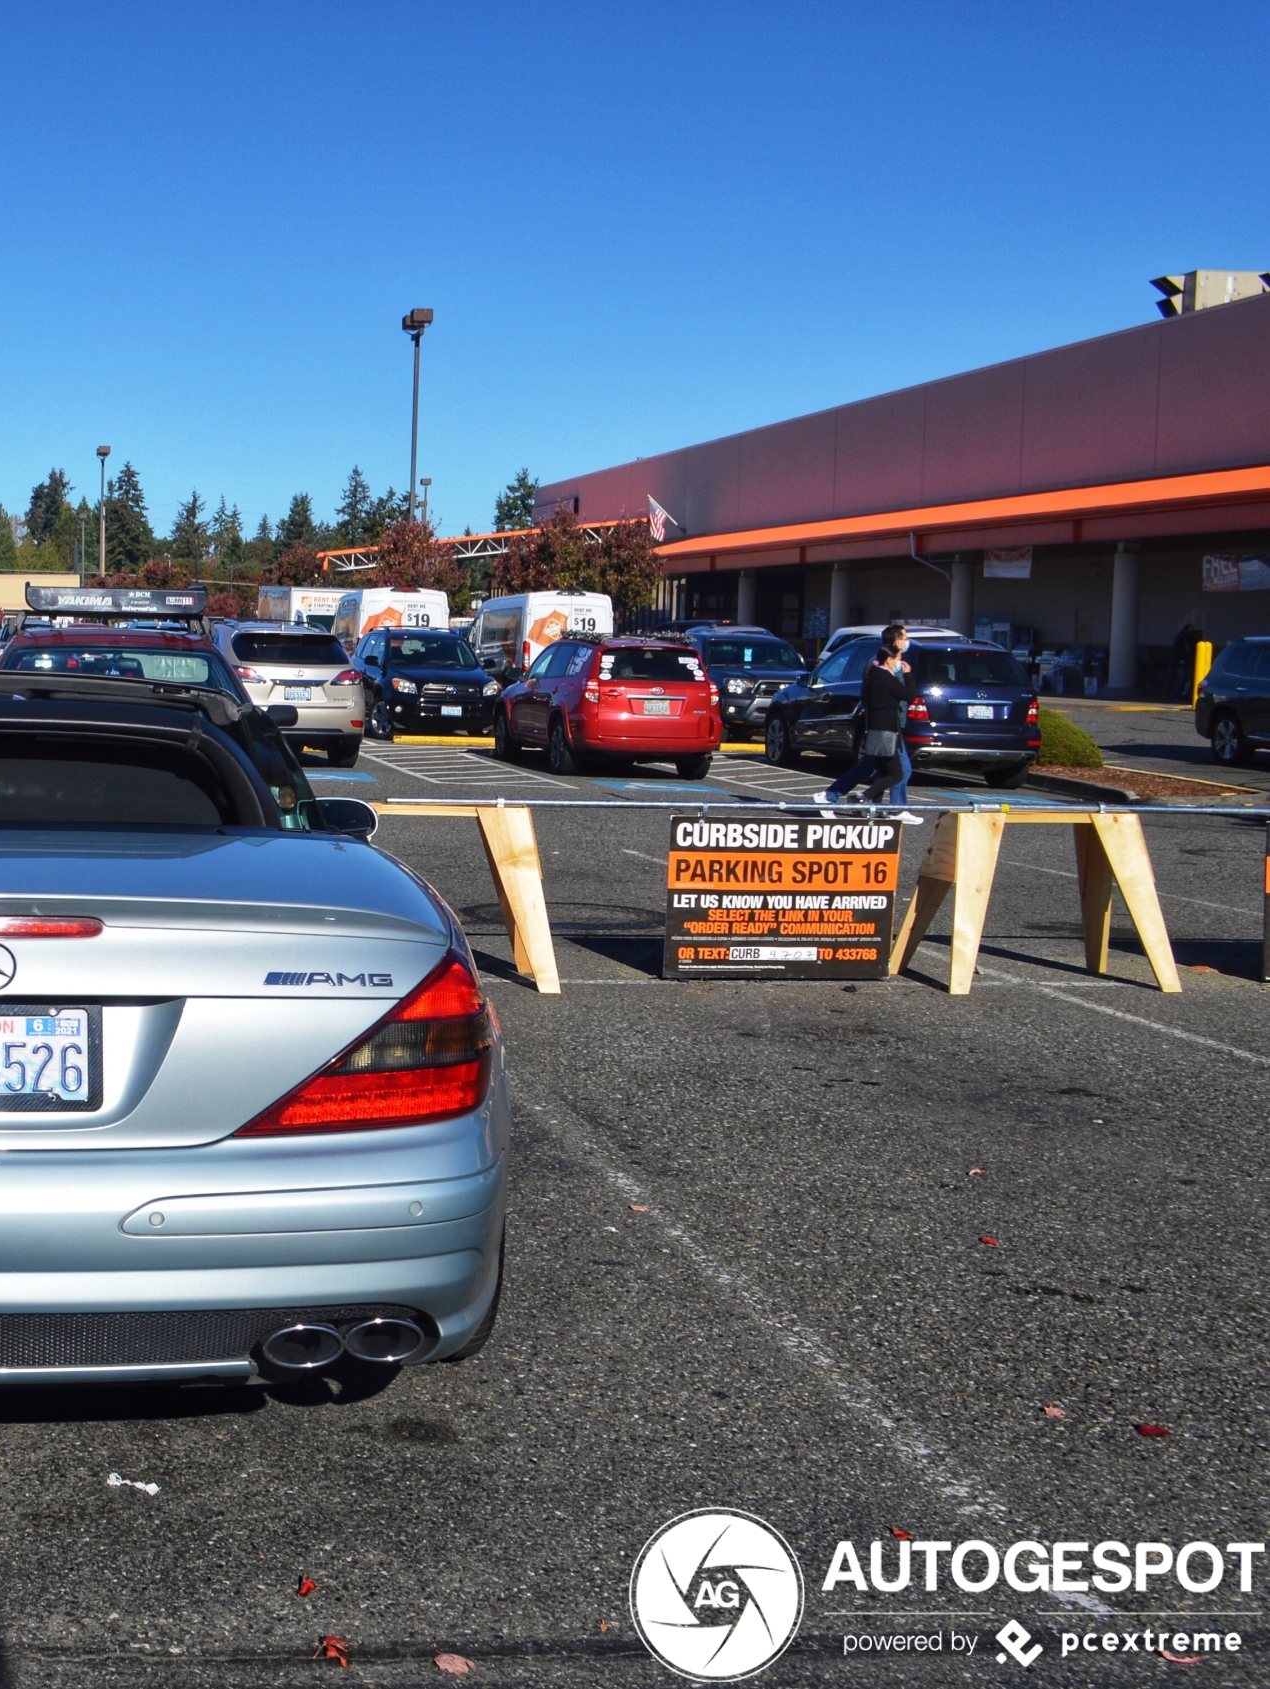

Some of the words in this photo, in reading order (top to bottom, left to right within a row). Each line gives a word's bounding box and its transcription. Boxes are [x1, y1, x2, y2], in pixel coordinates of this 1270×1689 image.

[1203, 555, 1238, 578] FREE
[57, 596, 112, 606] YAKIMA
[407, 613, 430, 627] $19
[574, 617, 596, 632] $19
[676, 822, 799, 848] CURBSIDE
[806, 825, 894, 849] PICKUP
[675, 858, 783, 884] PARKING
[792, 860, 853, 884] SPOT
[862, 861, 887, 884] 16
[673, 894, 697, 908] LET
[700, 895, 719, 908] US
[722, 895, 766, 909] KNOW
[766, 896, 792, 909] YOU
[795, 896, 829, 909] HAVE
[831, 896, 887, 910] ARRIVED
[708, 909, 751, 921] SELECT
[753, 910, 776, 922] THE
[778, 910, 805, 922] LINK
[807, 910, 819, 922] IN
[822, 910, 853, 922] YOUR
[780, 923, 875, 935] COMMUNICATION
[678, 947, 696, 960] OR
[697, 947, 729, 960] TEXT:
[731, 948, 760, 959] CURB
[818, 948, 833, 960] TO
[835, 948, 877, 960] 433768
[304, 972, 393, 987] AMG
[33, 1019, 44, 1032] 6
[55, 1027, 77, 1035] 2021
